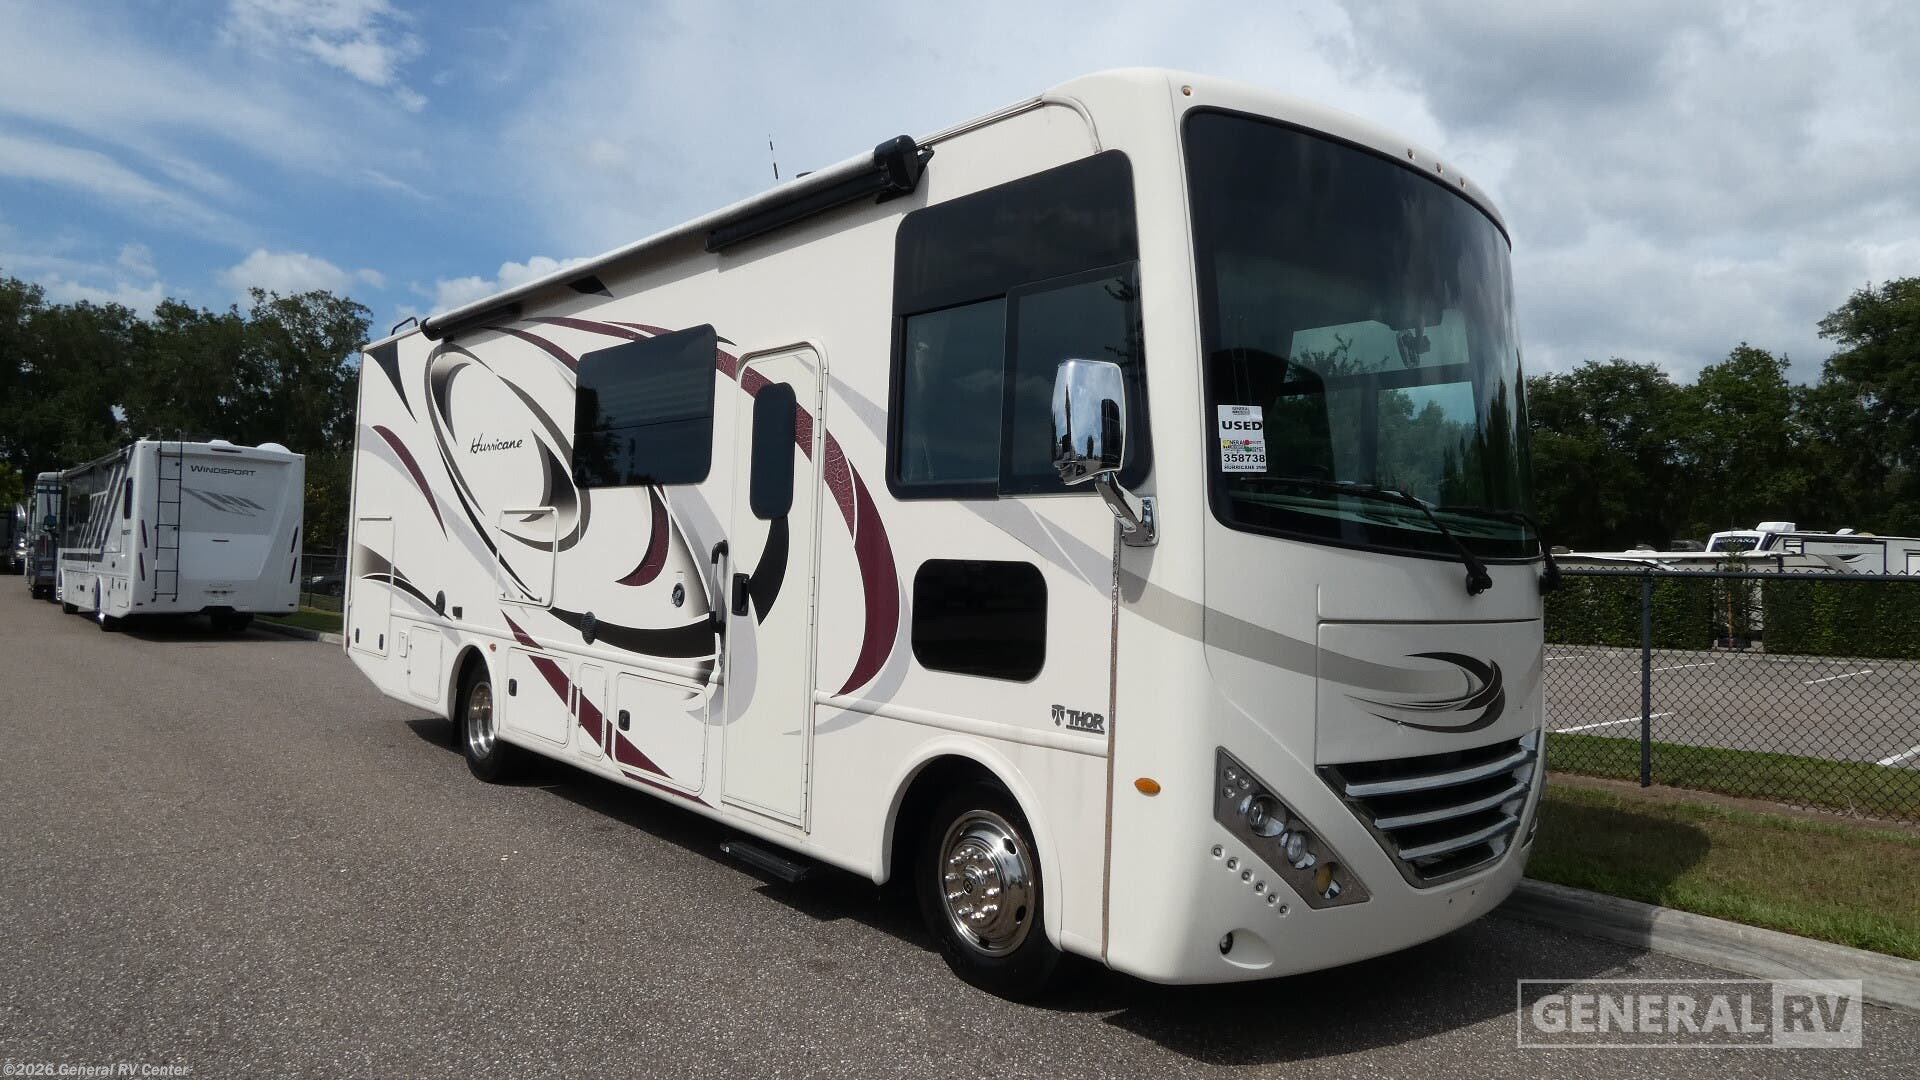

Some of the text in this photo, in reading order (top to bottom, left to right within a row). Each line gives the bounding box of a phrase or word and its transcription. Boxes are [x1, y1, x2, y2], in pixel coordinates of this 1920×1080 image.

[1222, 420, 1263, 430] USED
[470, 432, 523, 454] Hurricane
[1224, 454, 1265, 462] 358738
[190, 465, 256, 476] WINDSPORT
[1066, 709, 1104, 730] THOR
